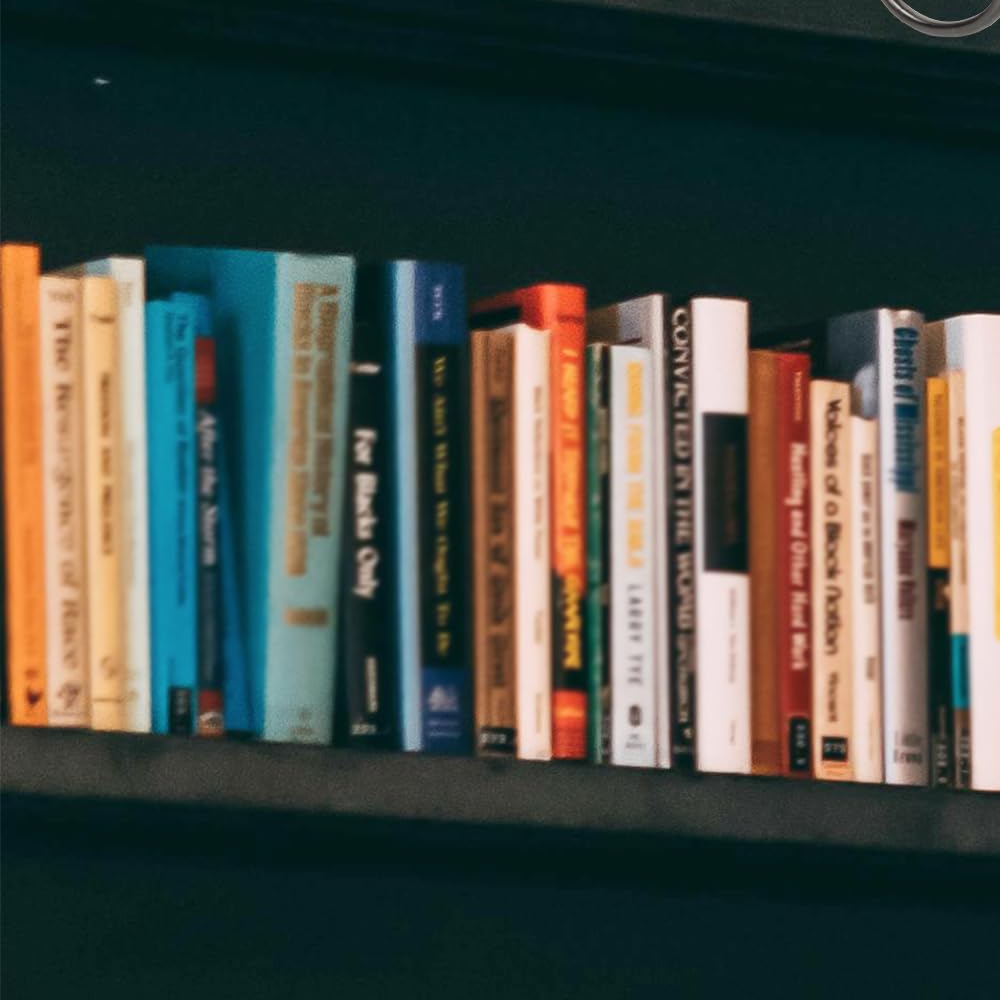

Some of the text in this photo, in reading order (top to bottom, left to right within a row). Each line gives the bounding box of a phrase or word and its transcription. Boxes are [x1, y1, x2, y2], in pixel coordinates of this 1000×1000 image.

[51, 316, 82, 670] The Resurgence of Race
[197, 409, 218, 566] After the Storm
[433, 443, 449, 494] What
[672, 307, 694, 630] CONVICTED IN THE WOMB
[887, 326, 921, 494] Ghosts of Mississippi
[351, 428, 380, 598] For Blacks Only
[784, 442, 809, 670] Hustling and Other Hard Work
[825, 399, 844, 656] Voices of a Black Nation
[627, 584, 644, 687] LARRY TYE
[828, 671, 841, 723] Vincent
